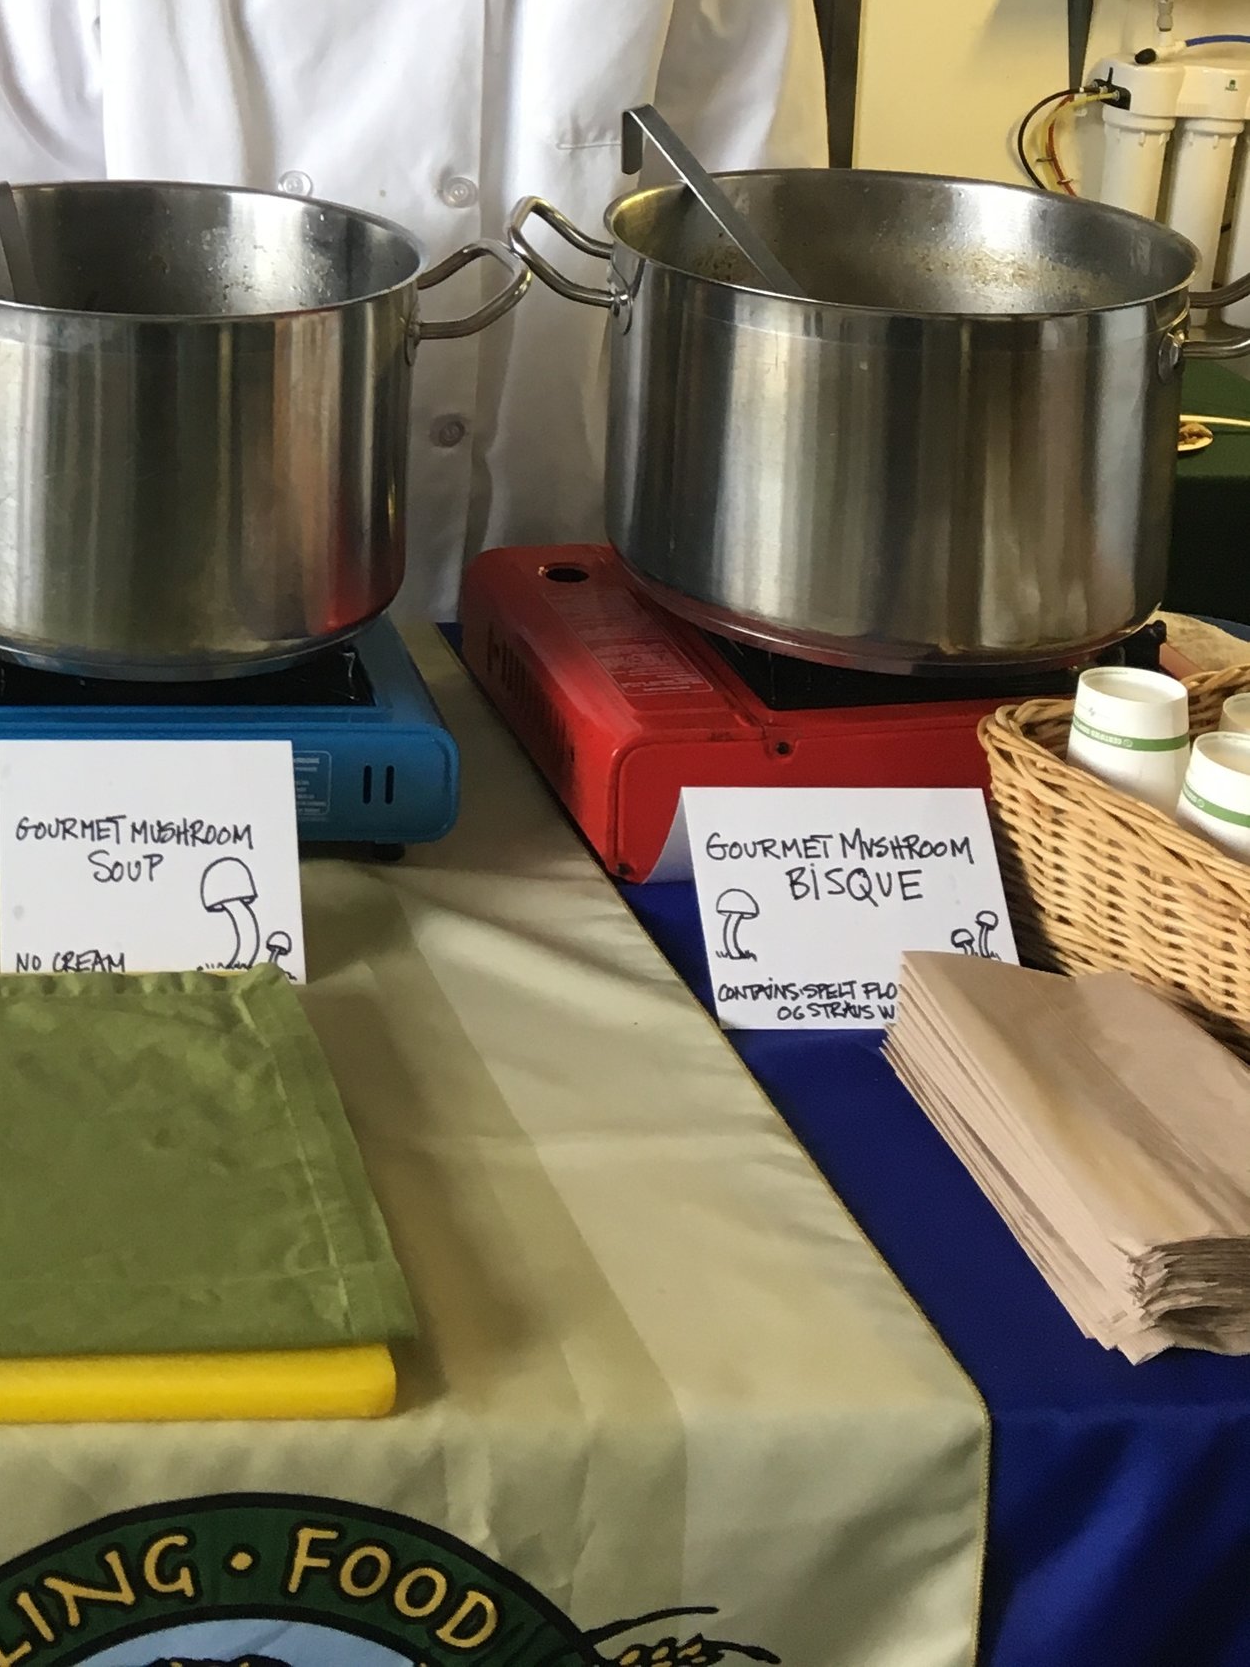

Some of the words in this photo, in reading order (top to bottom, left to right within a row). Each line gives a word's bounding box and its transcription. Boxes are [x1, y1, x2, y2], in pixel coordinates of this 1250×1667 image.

[15, 815, 127, 844] GOURMET
[130, 818, 254, 849] MUSHROOM
[706, 832, 833, 860] GOURMET
[839, 828, 974, 864] MUSHROOM
[16, 952, 41, 973] NO
[52, 950, 126, 973] CREAM
[863, 982, 898, 1000] FLO
[881, 1004, 896, 1019] W
[287, 1526, 499, 1649] FOOD
